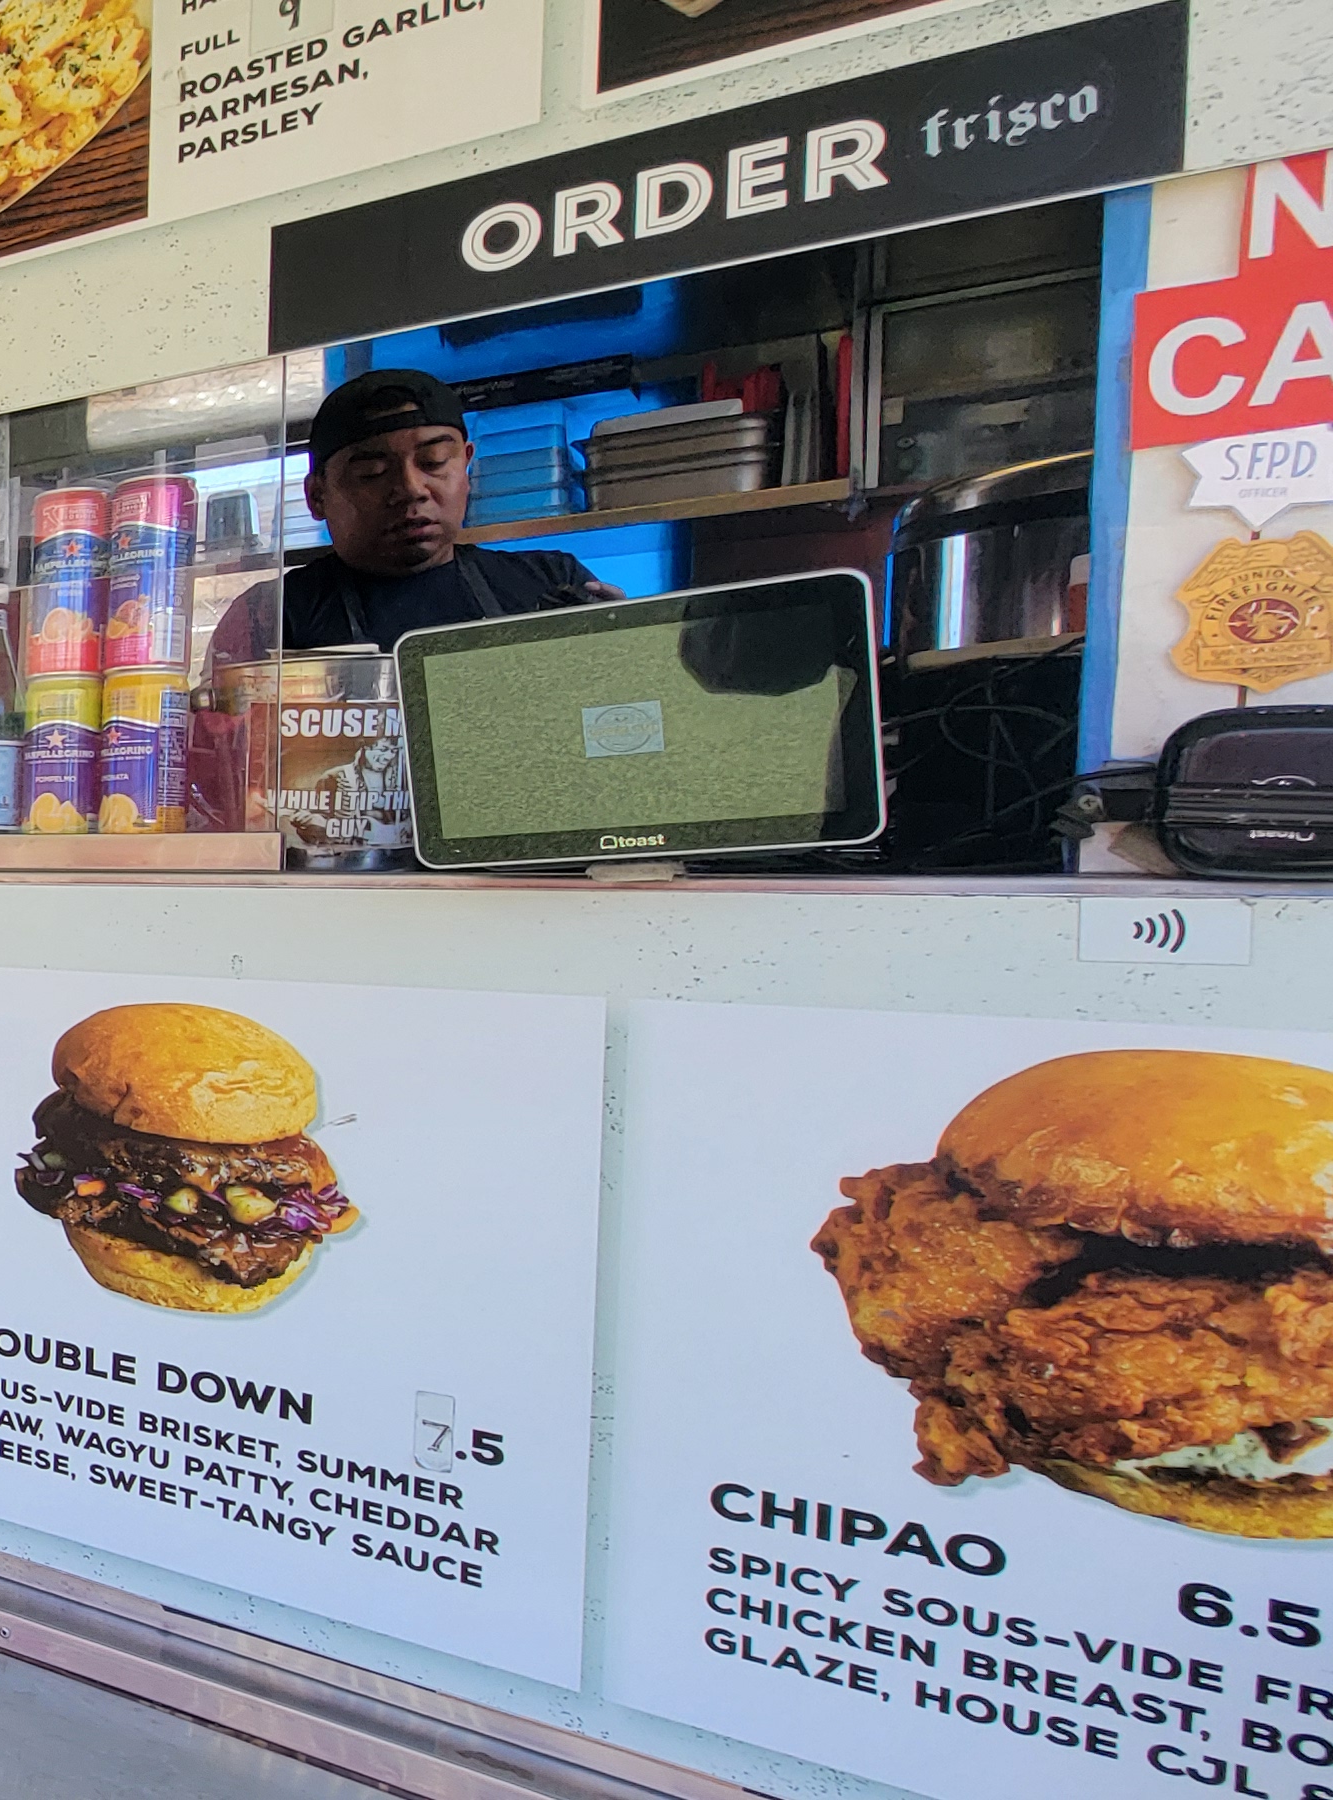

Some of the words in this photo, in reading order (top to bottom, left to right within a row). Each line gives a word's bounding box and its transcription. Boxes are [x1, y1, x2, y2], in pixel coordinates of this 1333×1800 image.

[180, 38, 328, 102] ROASTED
[343, 0, 486, 48] GARLIC,
[181, 29, 240, 61] FULL
[178, 103, 322, 163] PARSLEY
[179, 58, 368, 133] PARMESAN,
[921, 84, 1099, 158] frisco
[459, 119, 889, 272] ORDER
[1238, 487, 1288, 498] OFFICER
[268, 789, 330, 810] WHILE
[335, 791, 341, 810] I
[348, 791, 379, 810] TIP
[326, 818, 367, 838] GUY
[619, 834, 666, 847] toast
[157, 1362, 313, 1426] DOWN
[58, 1422, 169, 1470] WAGYU
[184, 1455, 293, 1506] PATTY,
[309, 1487, 499, 1556] CHEDDAR
[139, 1413, 281, 1469] BRISKET,
[298, 1449, 463, 1510] SUMMER
[89, 1463, 336, 1547] SWEET-TANGY
[352, 1533, 482, 1590] SAUCE
[711, 1482, 1007, 1576] CHIPAO
[1178, 1582, 1321, 1648] 6.5
[708, 1548, 859, 1602] SPICY
[883, 1588, 1223, 1694] SOUS-VIDE
[705, 1588, 937, 1668] CHICKEN
[963, 1649, 1211, 1742] BREAST,
[705, 1628, 889, 1702] GLAZE,
[915, 1682, 1118, 1759] HOUSE
[1147, 1744, 1268, 1800] CJL
